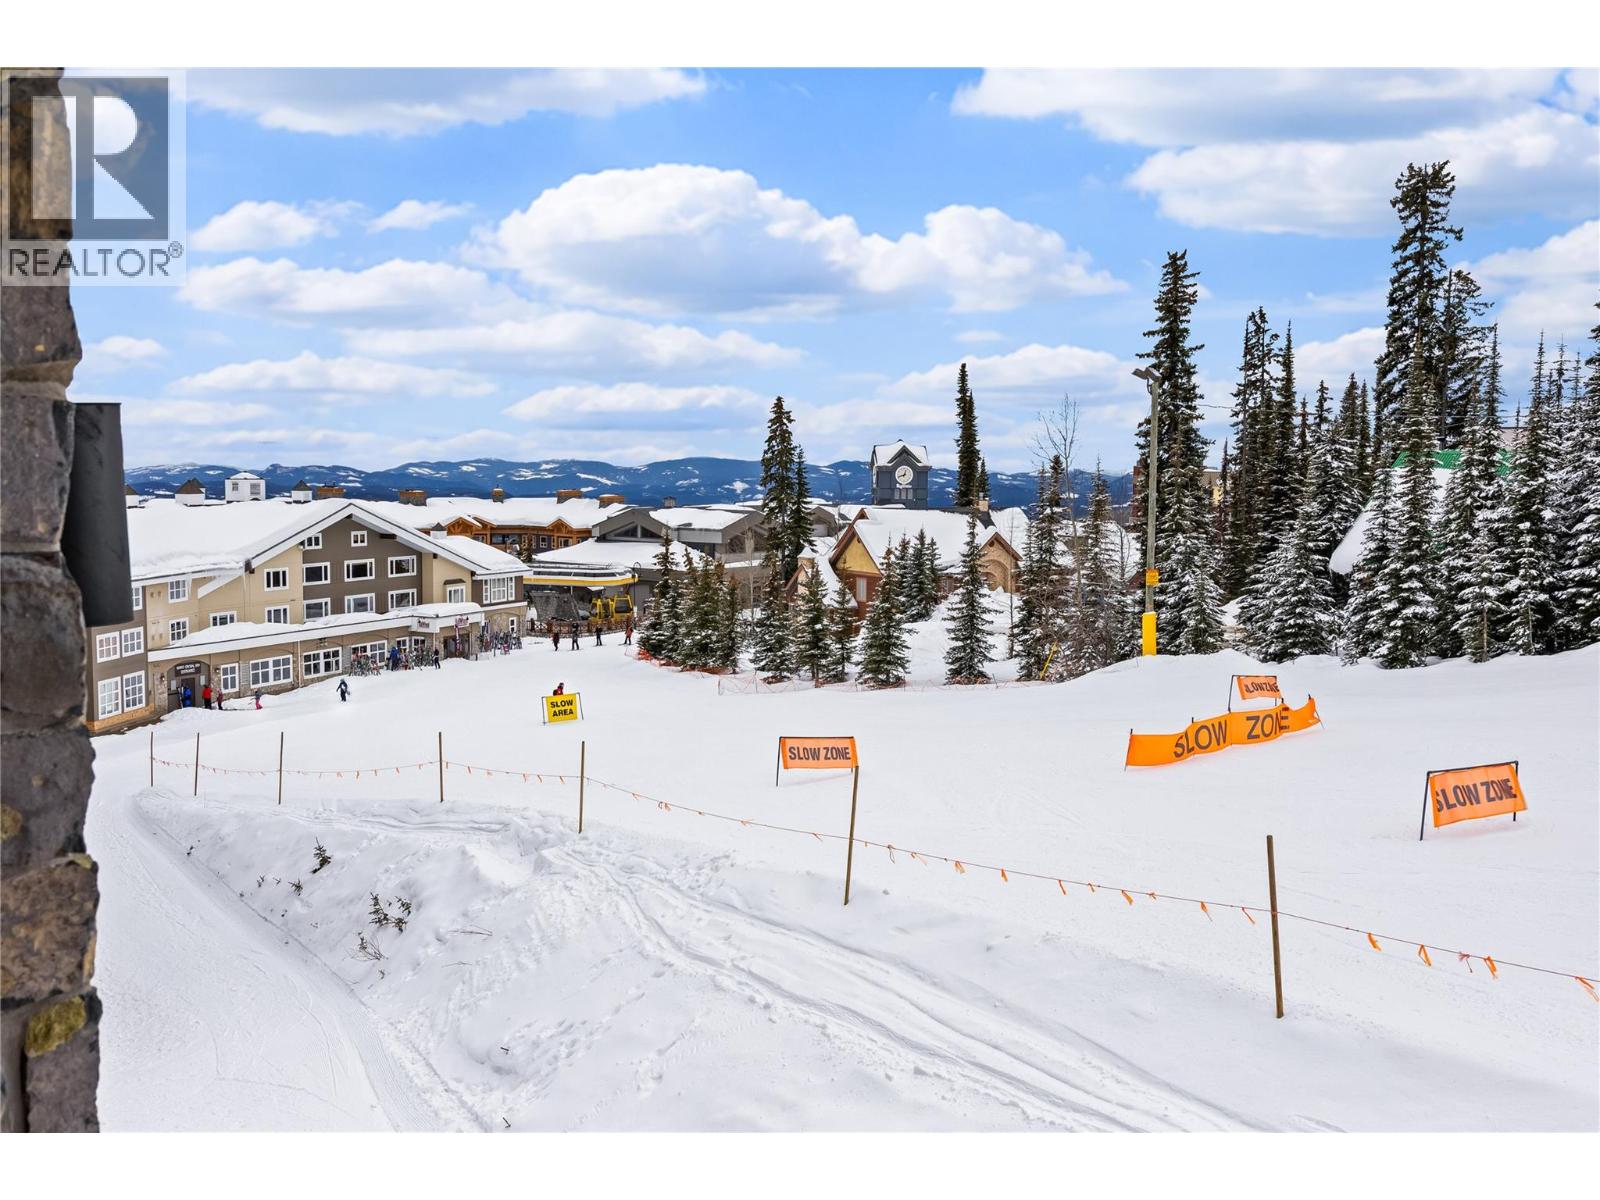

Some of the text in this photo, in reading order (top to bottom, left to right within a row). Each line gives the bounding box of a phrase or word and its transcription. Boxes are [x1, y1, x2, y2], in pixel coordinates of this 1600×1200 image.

[550, 700, 573, 708] SLOW
[552, 708, 573, 717] AREA
[1174, 707, 1290, 758] SLOW ZONE
[788, 746, 851, 760] SLOW ZONE
[1436, 778, 1517, 812] SLOW ZONE
